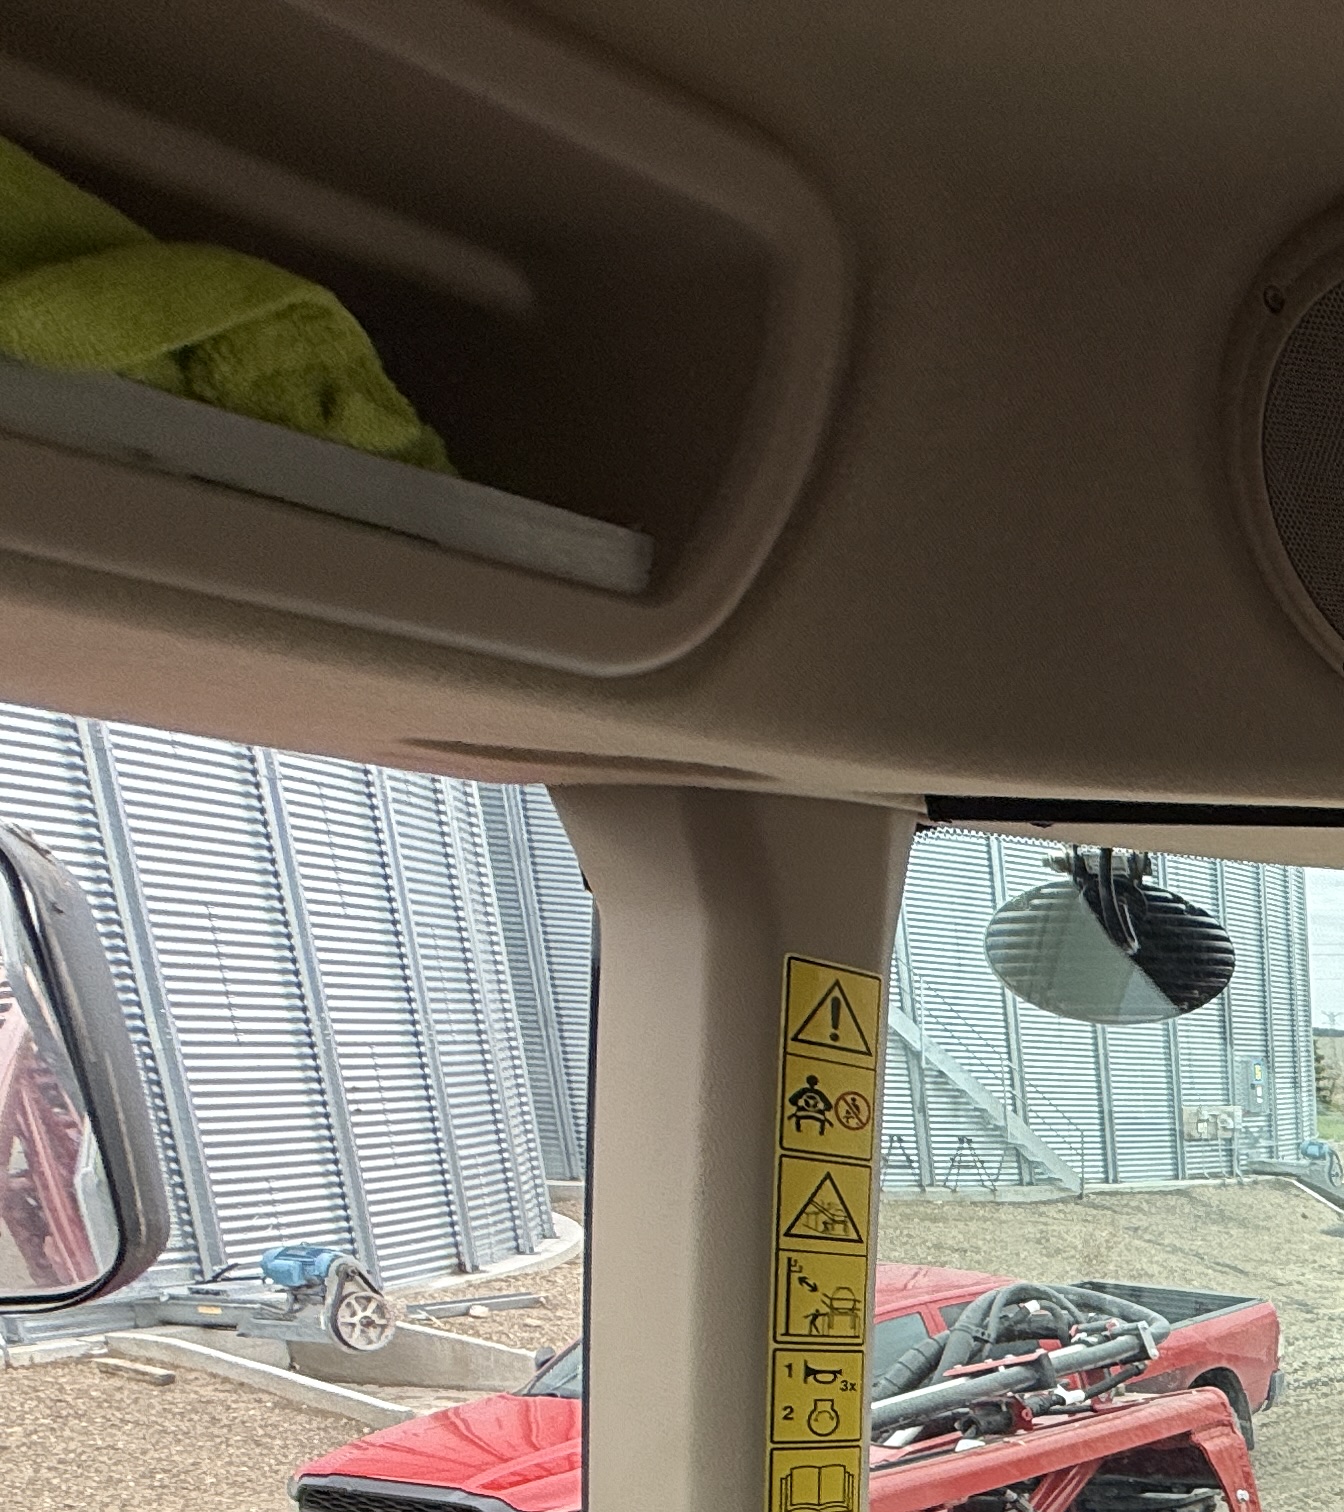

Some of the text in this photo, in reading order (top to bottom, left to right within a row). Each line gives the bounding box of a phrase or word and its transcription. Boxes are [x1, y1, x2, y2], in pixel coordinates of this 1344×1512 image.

[784, 1363, 793, 1378] 1
[839, 1379, 858, 1393] 3x
[781, 1405, 795, 1421] 2
